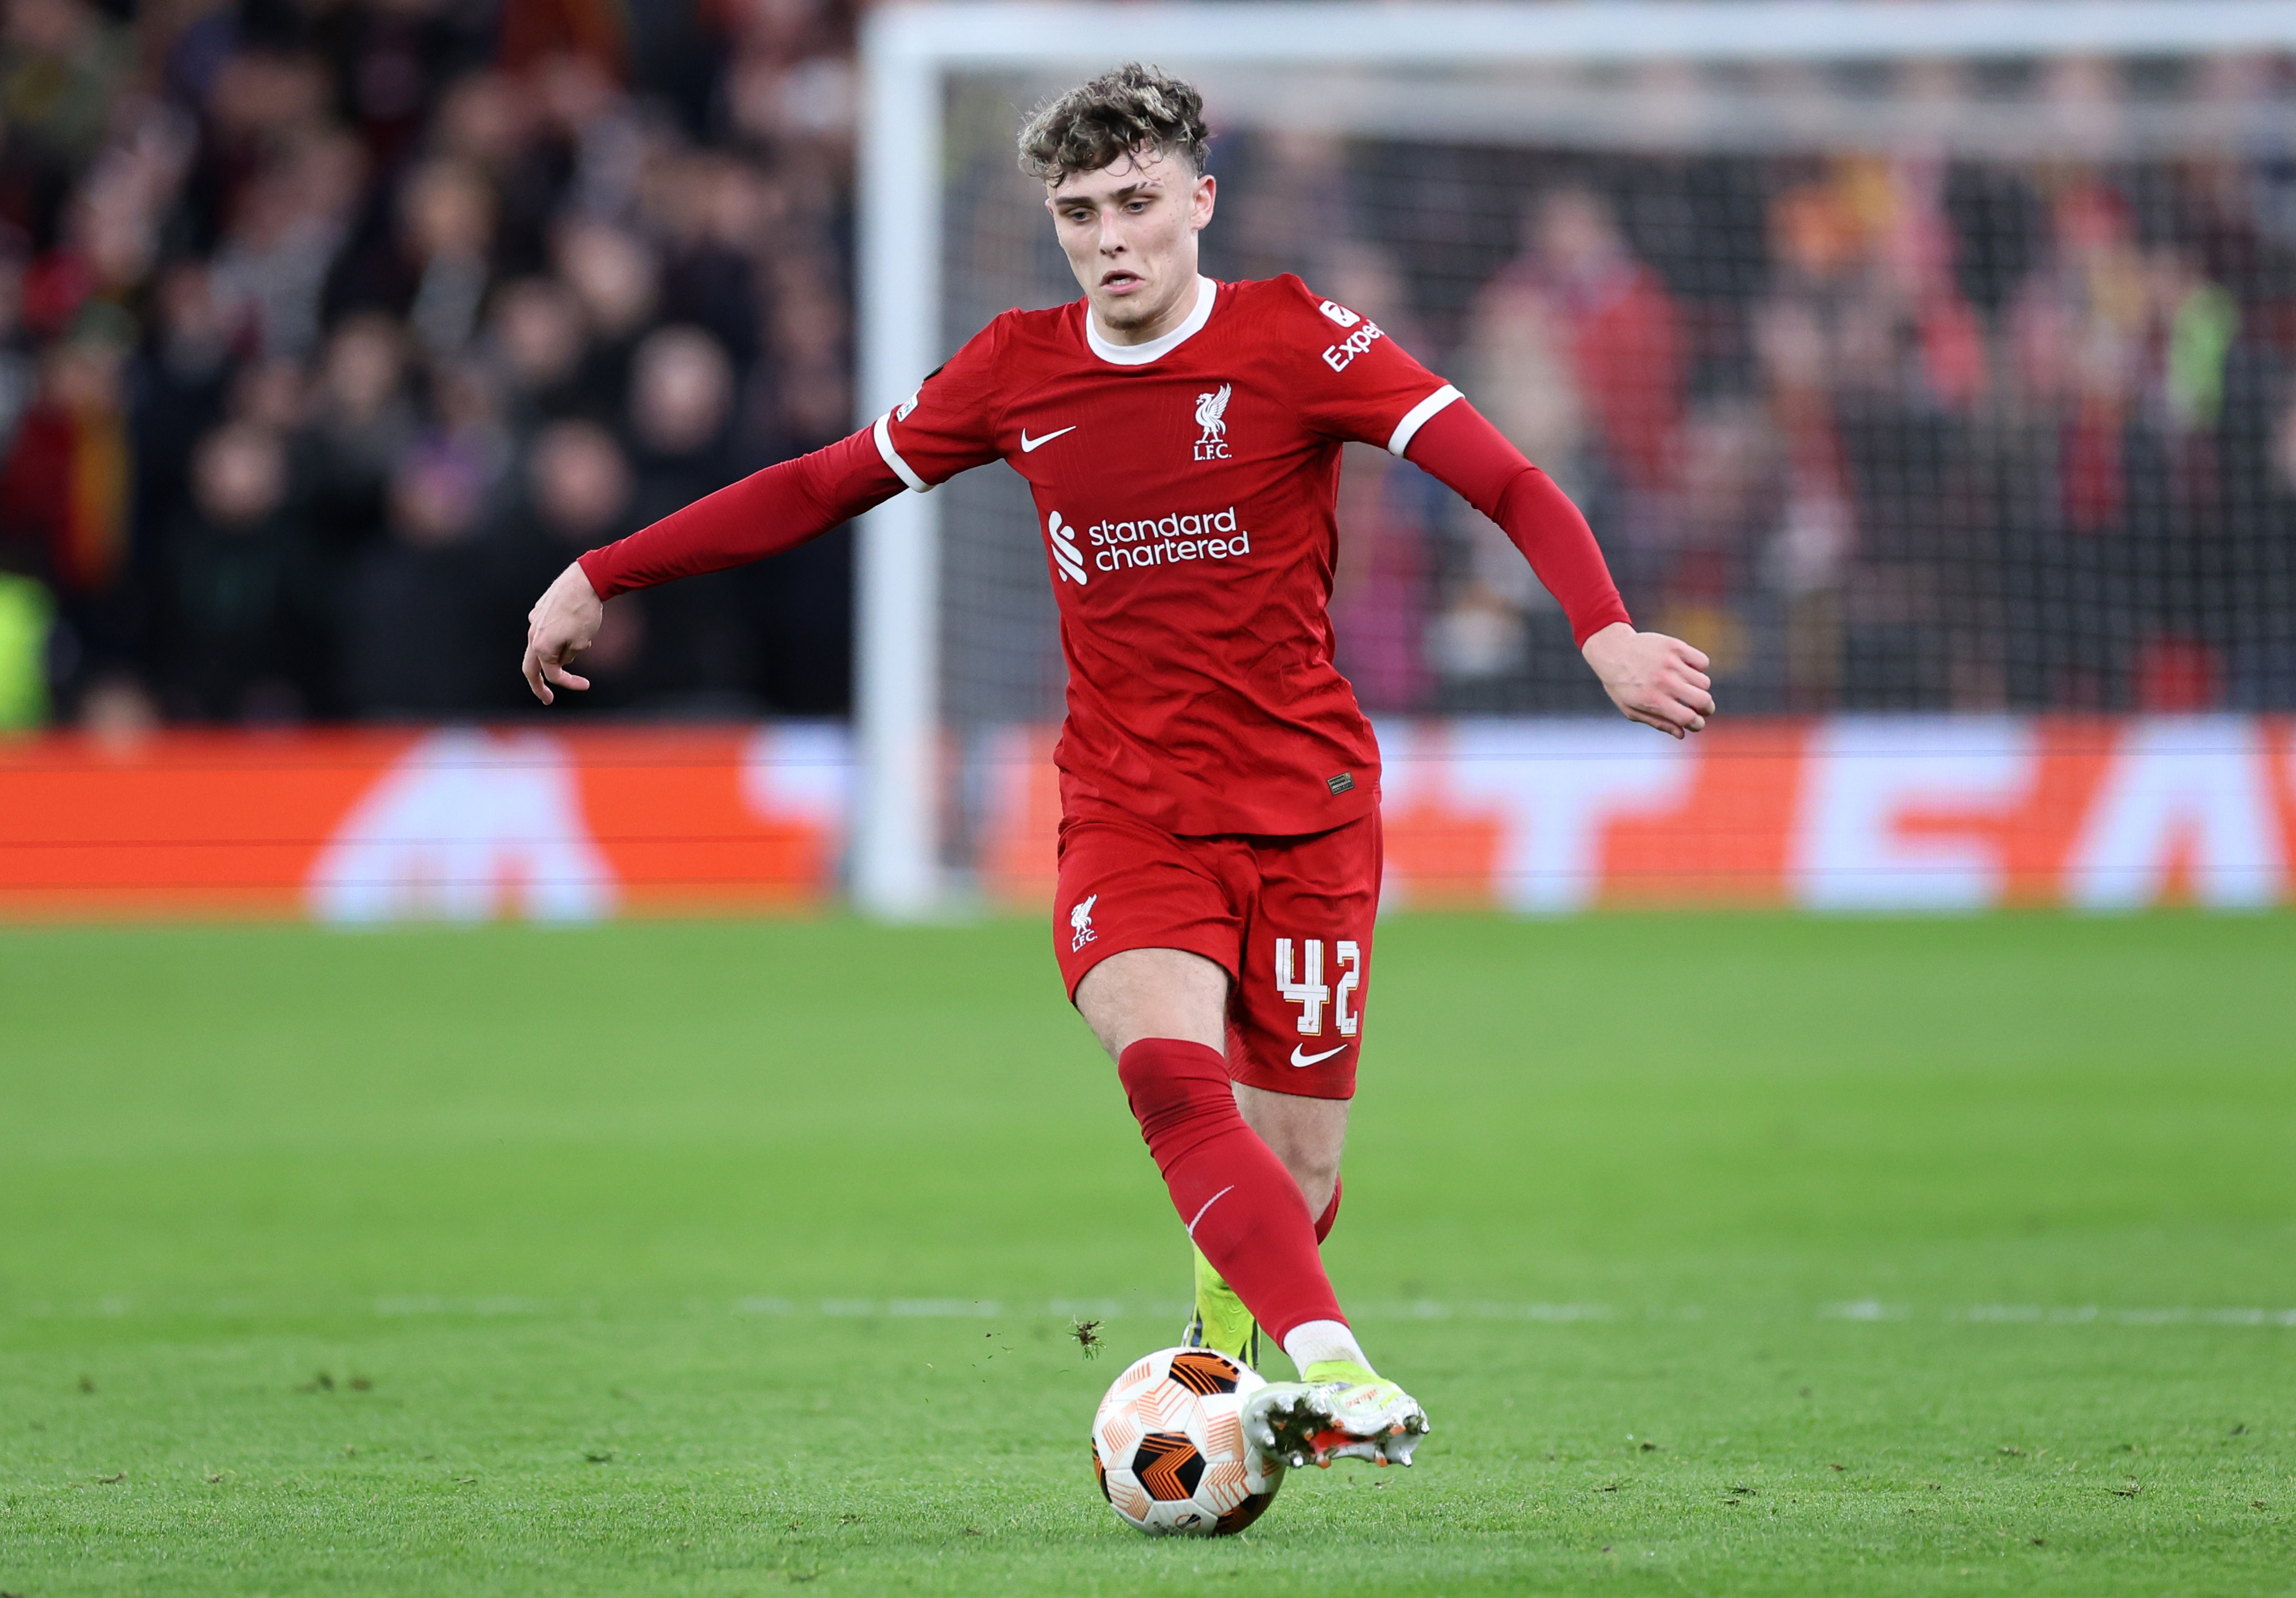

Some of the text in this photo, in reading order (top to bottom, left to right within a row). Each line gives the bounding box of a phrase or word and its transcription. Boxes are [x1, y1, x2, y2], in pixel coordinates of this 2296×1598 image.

[1194, 443, 1232, 461] L.F.C.
[1089, 506, 1236, 545] standard
[1096, 530, 1250, 571] chartered
[1275, 938, 1362, 1037] 42
